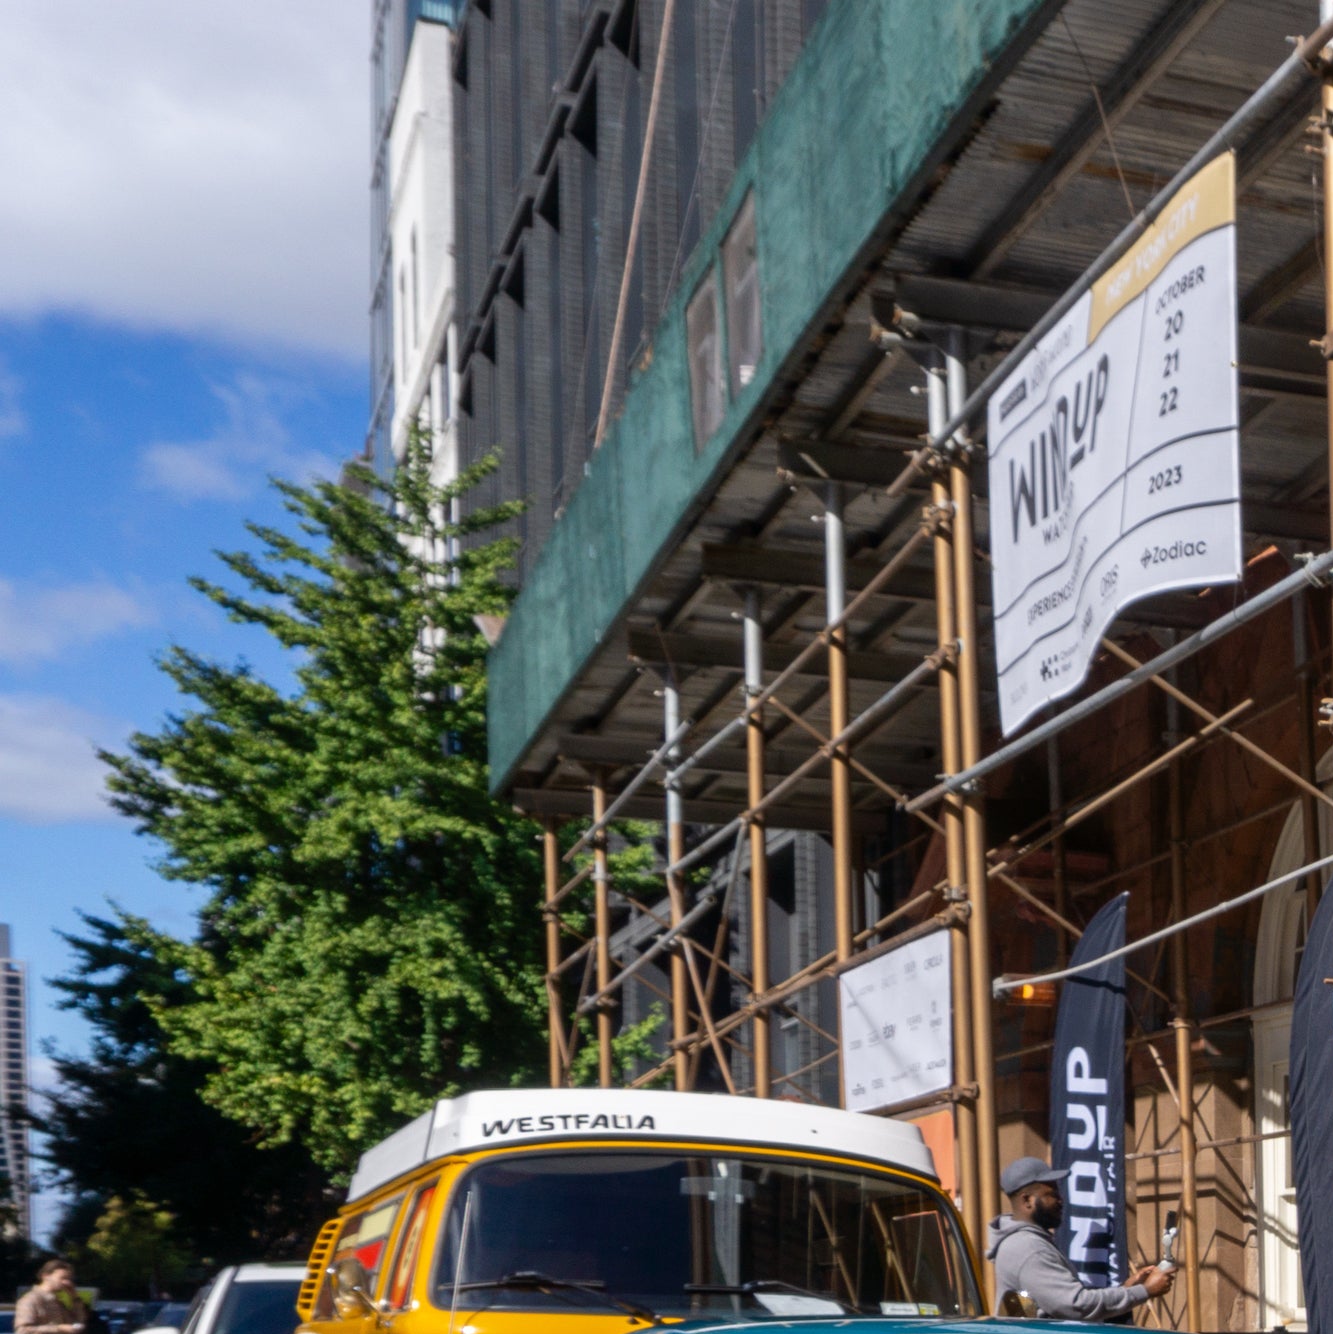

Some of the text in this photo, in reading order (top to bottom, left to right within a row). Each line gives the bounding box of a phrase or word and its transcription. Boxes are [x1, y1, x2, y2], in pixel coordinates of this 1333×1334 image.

[1164, 310, 1184, 342] 20
[1162, 349, 1180, 379] 21
[1158, 387, 1179, 417] 22
[1148, 464, 1183, 495] 2023
[1153, 539, 1208, 565] Zodiac
[482, 1113, 656, 1138] WESTFALIA
